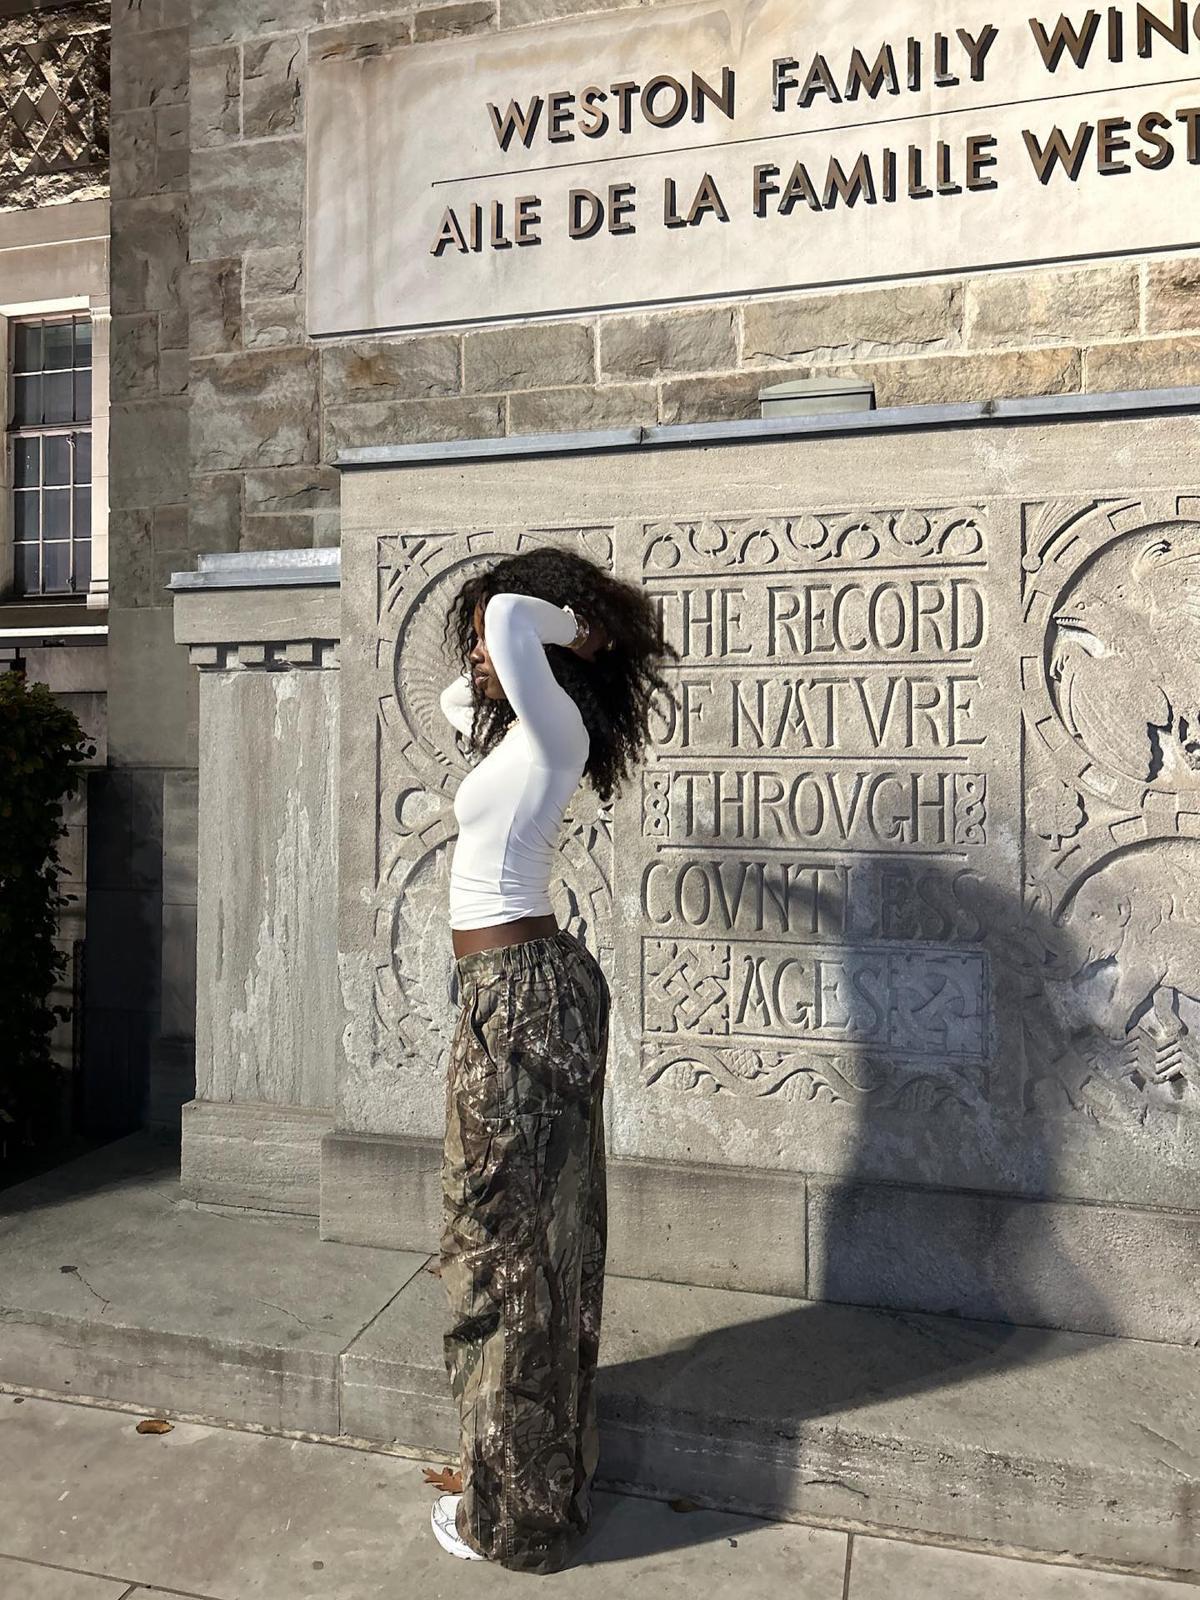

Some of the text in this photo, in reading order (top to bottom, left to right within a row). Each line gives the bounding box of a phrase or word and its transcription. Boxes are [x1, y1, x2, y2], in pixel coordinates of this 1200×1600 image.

[486, 0, 1200, 152] WESTON FAMILY WIN
[430, 107, 1200, 256] AILE DE LA FAMILLE WEST
[648, 577, 988, 658] THE RECORD
[730, 675, 988, 749] NATVRE
[673, 771, 955, 844] THROVGH
[641, 859, 988, 942] COVNTLESS
[734, 956, 883, 1034] AGES
